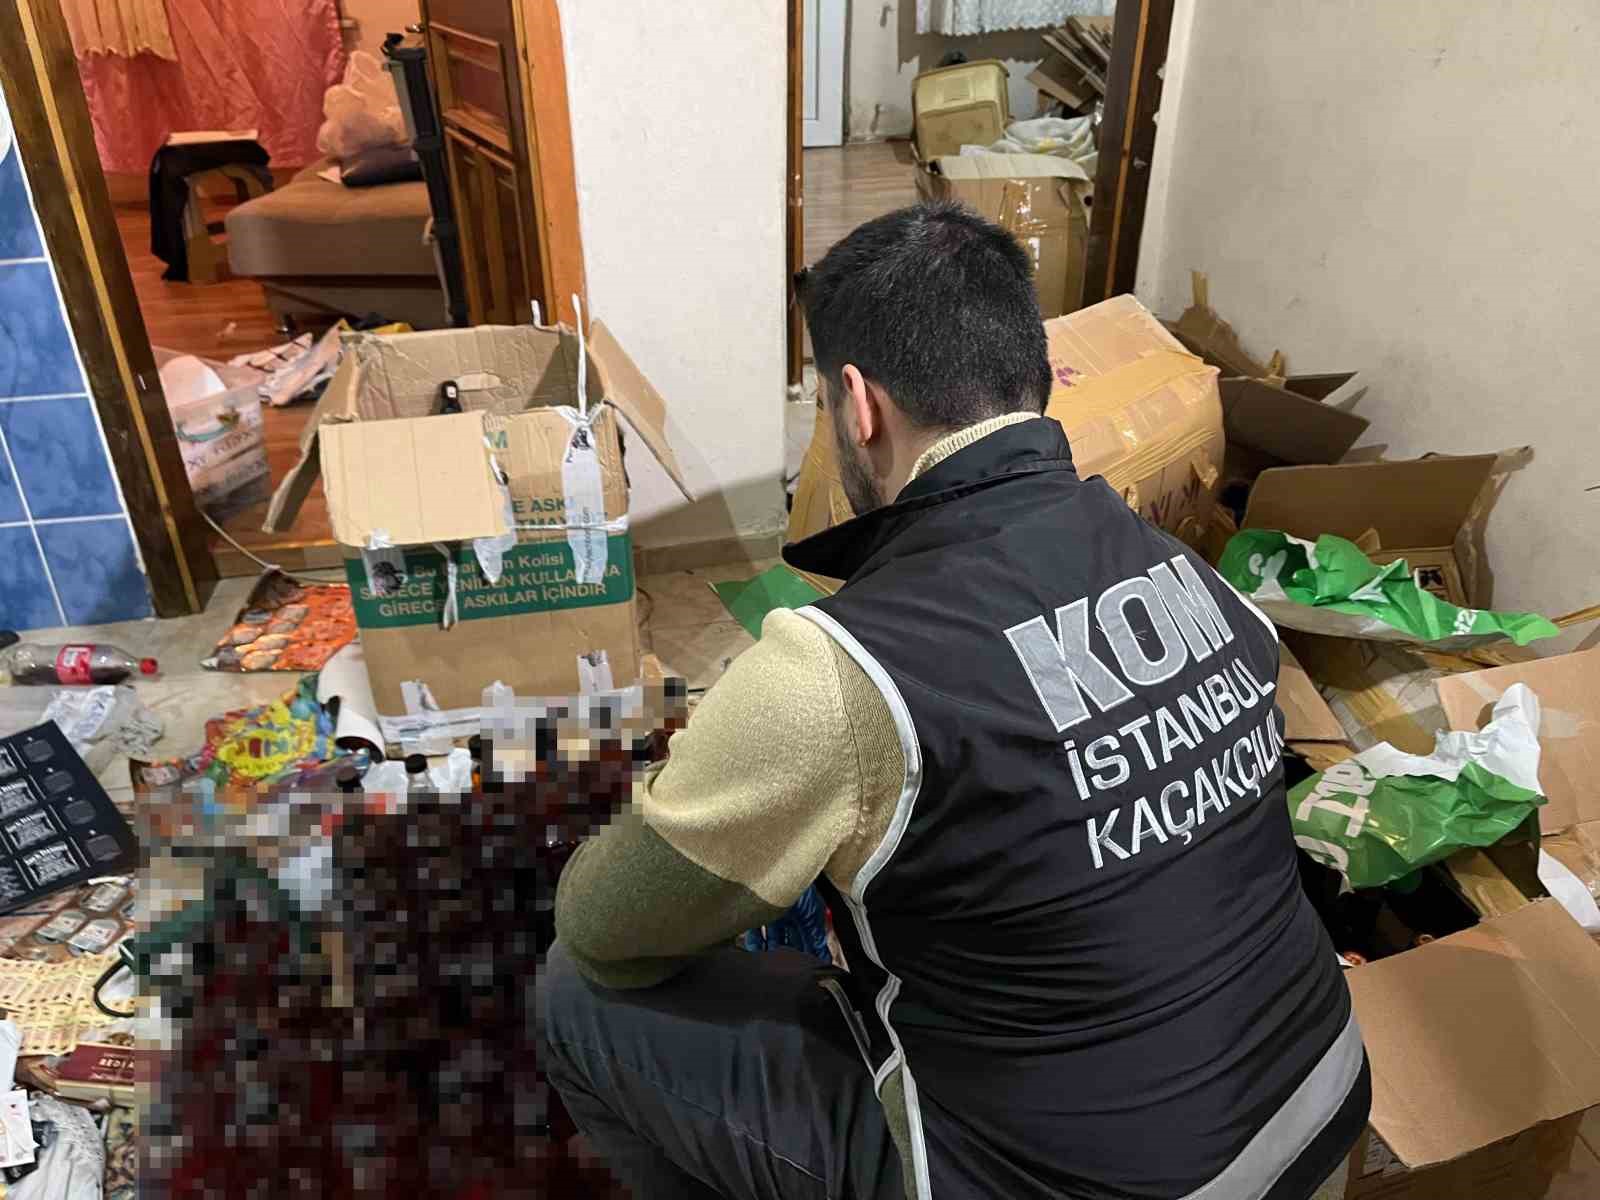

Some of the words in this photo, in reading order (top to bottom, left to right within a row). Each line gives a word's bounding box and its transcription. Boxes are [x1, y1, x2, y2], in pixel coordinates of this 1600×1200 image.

[519, 552, 564, 569] Kolisi
[520, 564, 620, 586] KULLAA
[463, 590, 537, 609] ASKILAR
[542, 583, 607, 603] İÇİNDİR
[1003, 554, 1234, 733] KOM
[1063, 657, 1276, 800] İSTANBUL
